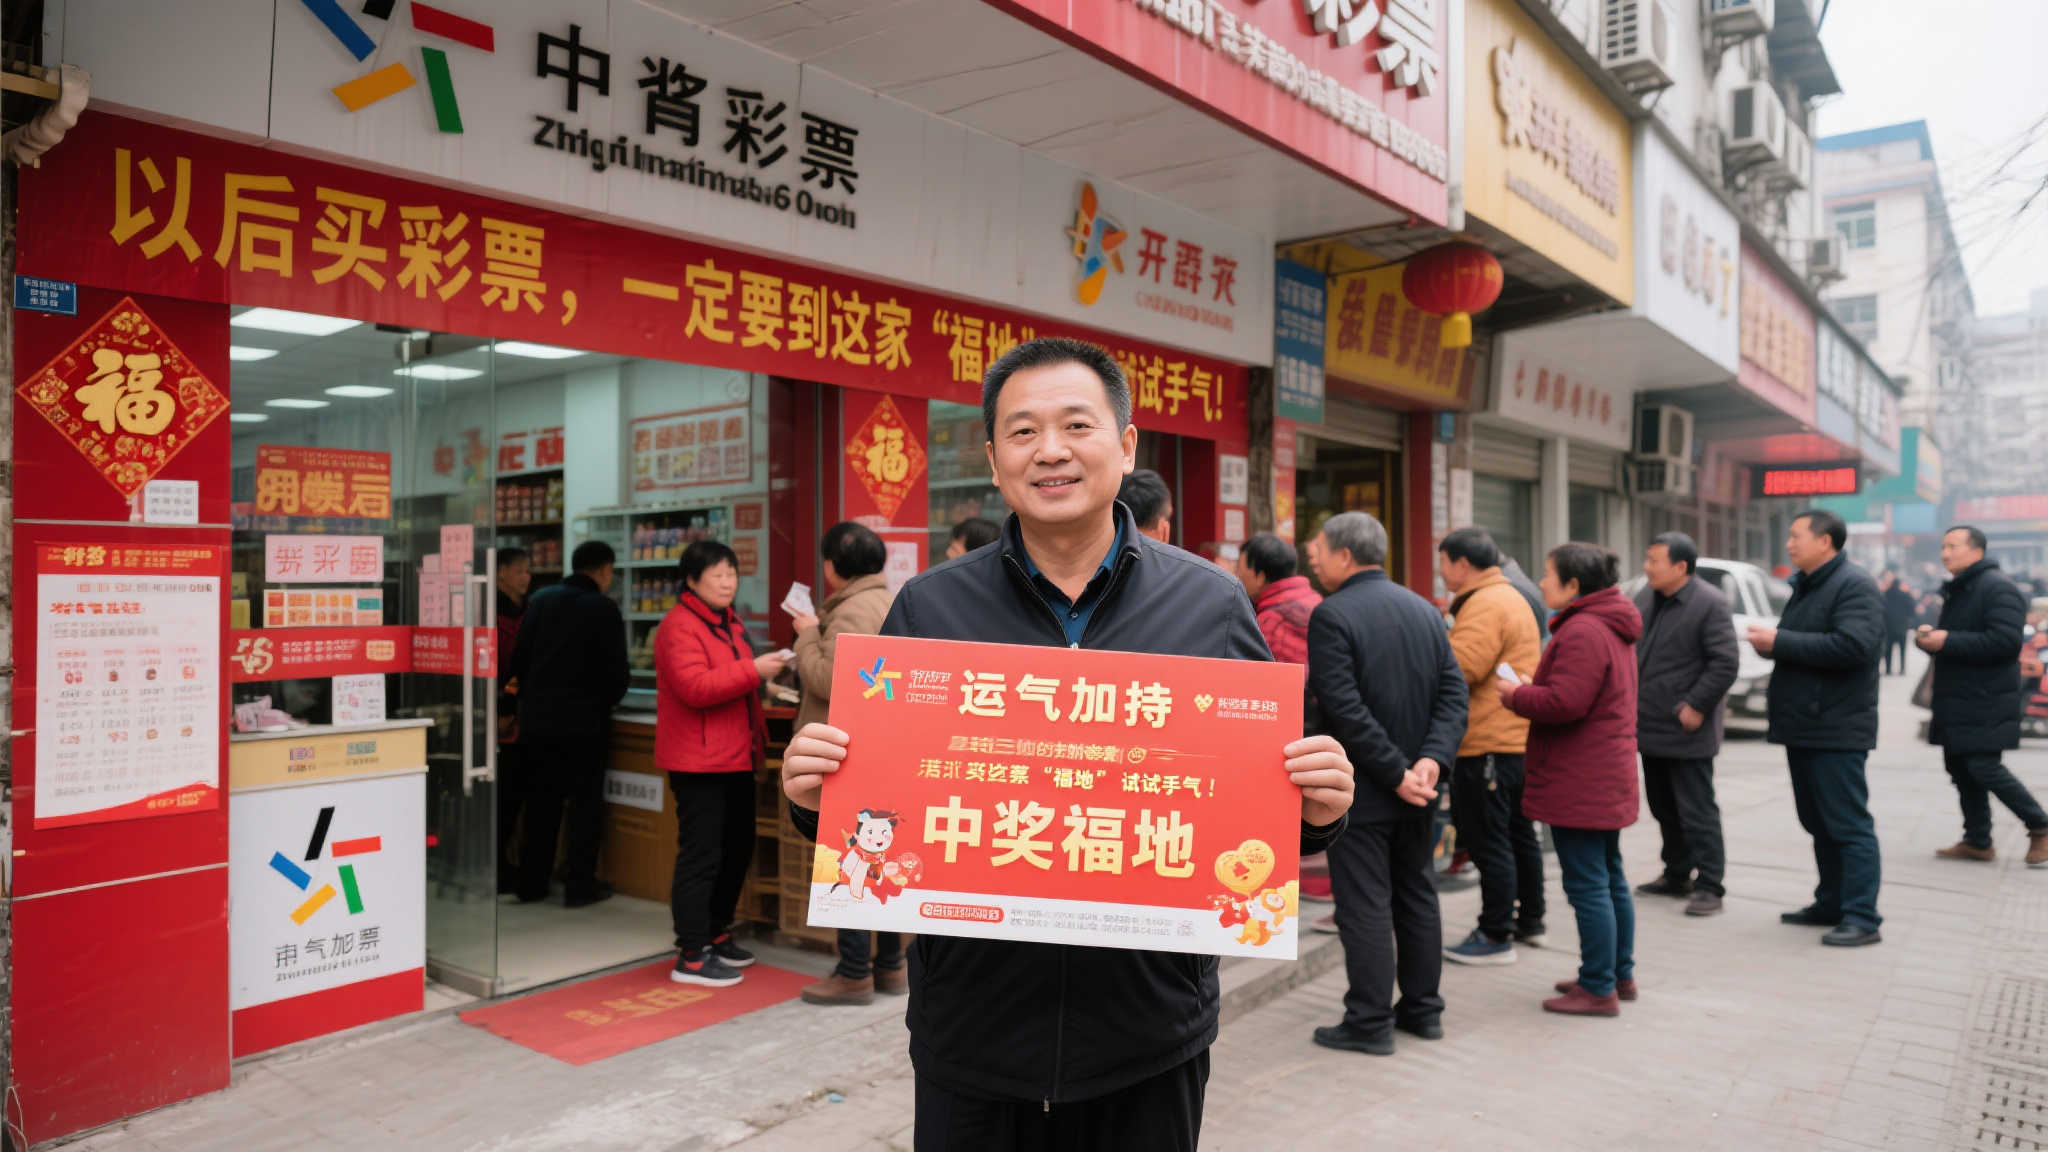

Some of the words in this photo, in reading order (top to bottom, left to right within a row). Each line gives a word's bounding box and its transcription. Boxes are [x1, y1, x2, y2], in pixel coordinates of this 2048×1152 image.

[74, 348, 176, 436] 福
[865, 424, 909, 483] 福
[958, 669, 1173, 729] 运气加持
[922, 796, 1196, 880] 中奖福地
